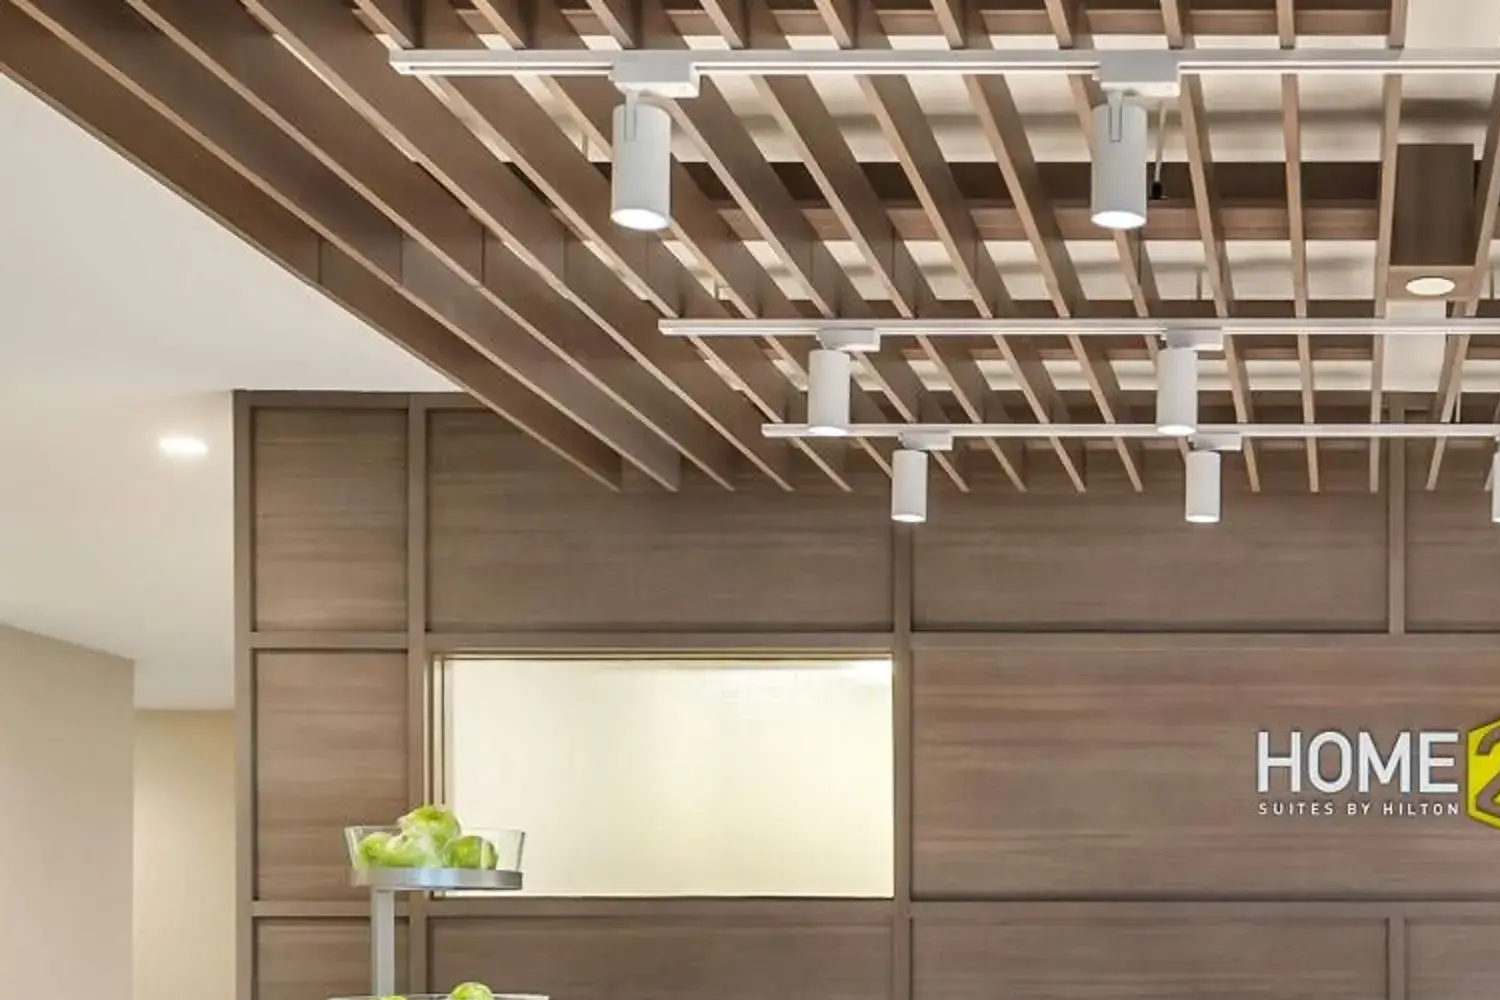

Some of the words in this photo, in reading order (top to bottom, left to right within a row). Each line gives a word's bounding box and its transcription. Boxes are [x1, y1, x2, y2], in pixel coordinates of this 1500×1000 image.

[1257, 731, 1459, 794] HOME
[1258, 803, 1334, 816] SUITES
[1347, 803, 1370, 816] BY
[1383, 803, 1459, 816] HILTON
